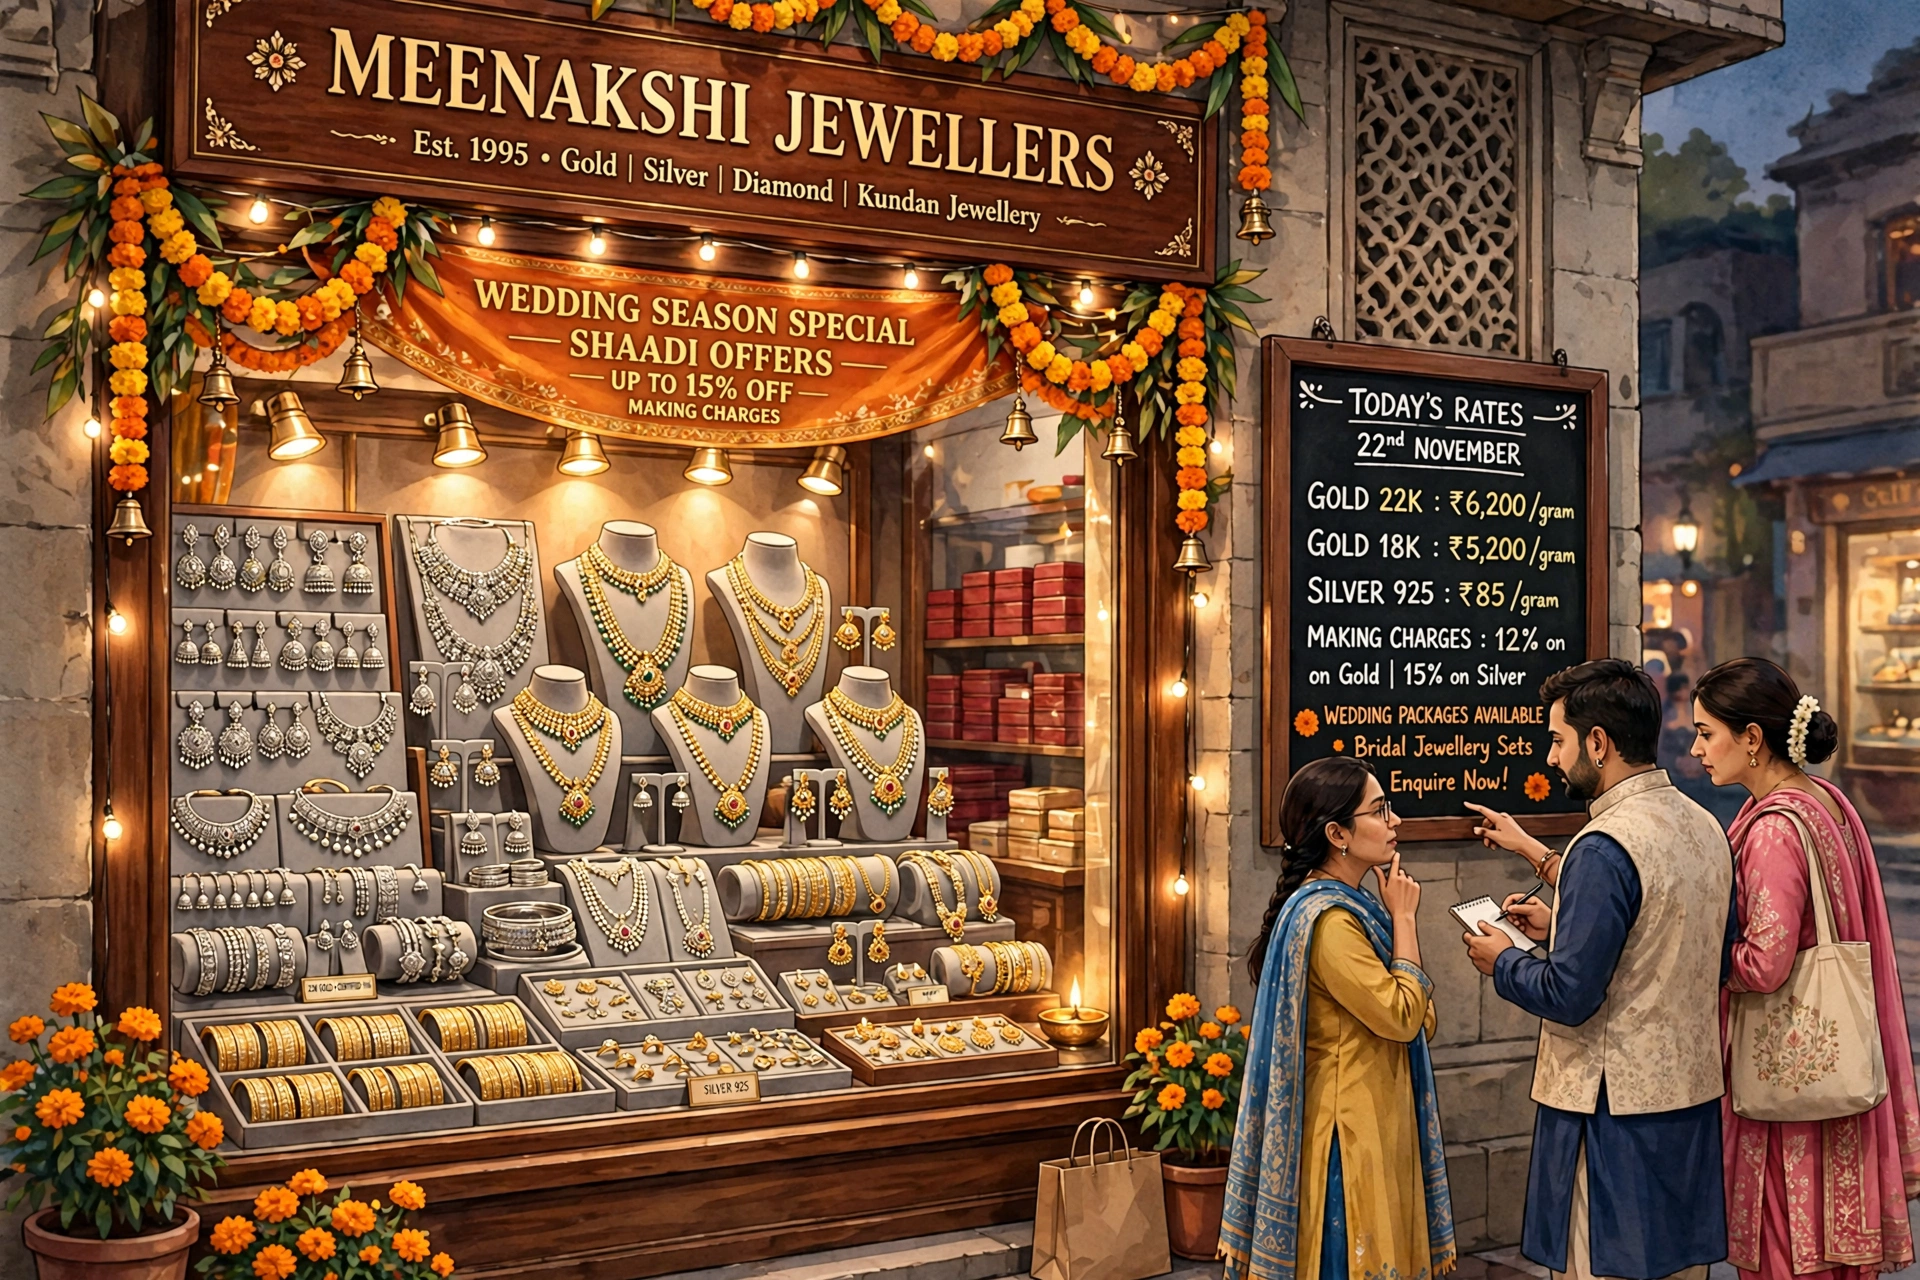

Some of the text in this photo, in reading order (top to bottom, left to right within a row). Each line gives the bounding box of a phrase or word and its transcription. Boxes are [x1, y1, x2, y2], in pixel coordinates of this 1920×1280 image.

[328, 27, 1115, 193] MEENAKSHI JEWELLERS
[413, 129, 459, 159] Est.
[470, 136, 529, 166] 1995
[561, 147, 617, 177] Gold
[643, 156, 709, 187] Silver
[732, 167, 834, 202] Diamond
[857, 183, 940, 215] Kundan
[946, 194, 1041, 233] Jewellery
[473, 278, 915, 346] WEDDING SEASON SPECIAL
[570, 328, 833, 377] SHAADI OFFERS
[611, 369, 794, 403] UP TO 15% OFF
[628, 398, 781, 425] MAKING CHARGES
[1348, 387, 1524, 427] TODAY'S RATES
[1357, 429, 1522, 466] 22nd NOVEMBER
[1307, 480, 1370, 511] GOLD
[1379, 487, 1423, 513] 22K
[1307, 528, 1370, 558] GOLD
[1379, 533, 1421, 559] 18K
[1307, 575, 1385, 605] SILVER
[1393, 579, 1434, 605] 925
[1307, 624, 1382, 649] MAKING
[1389, 625, 1472, 650] CHARGES
[1495, 626, 1539, 653] 12%
[1545, 638, 1566, 651] on
[1308, 670, 1330, 685] on
[1338, 661, 1380, 685] Gold
[1403, 661, 1443, 686] 15%
[1449, 671, 1470, 685] on
[1477, 663, 1527, 686] Silver
[1324, 705, 1544, 725] WEDDING PACKAGES AVAILABLE
[1354, 734, 1533, 764] Bridal Jewellery Sets
[1390, 766, 1508, 800] Enquire Now!
[703, 1080, 750, 1096] SILVER 925
